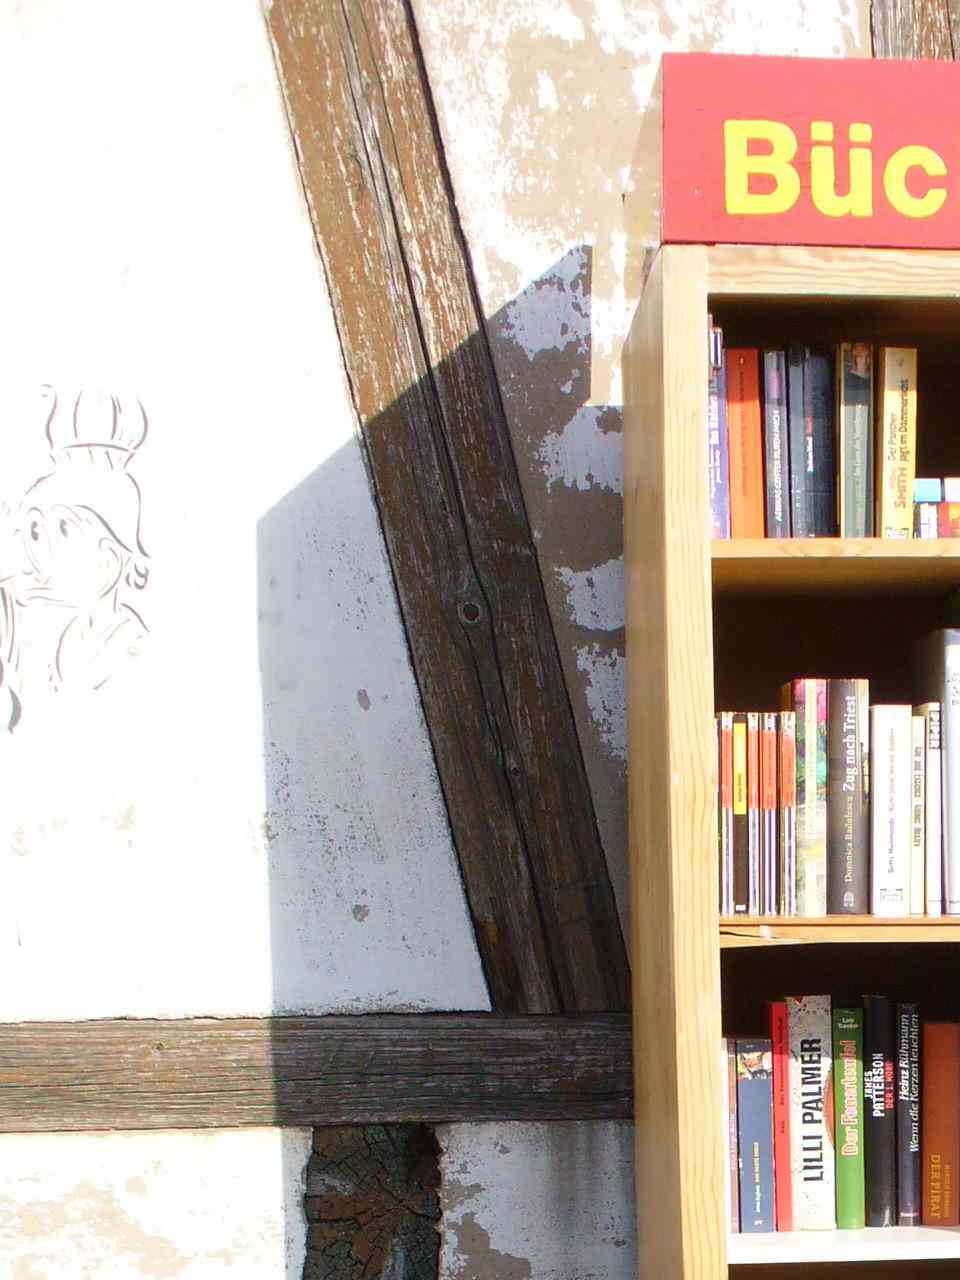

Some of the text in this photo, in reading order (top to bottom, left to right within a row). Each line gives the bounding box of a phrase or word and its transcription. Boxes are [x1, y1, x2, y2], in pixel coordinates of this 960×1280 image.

[893, 466, 907, 509] SMITH
[843, 695, 857, 732] Triest
[844, 735, 855, 765] nach
[843, 767, 858, 792] Zug
[898, 1014, 910, 1101] Heinz Rühmann
[908, 1014, 921, 1153] Wenn die Kerzen leuchten
[799, 1038, 824, 1182] LILLI PALMER
[864, 1070, 874, 1100] JAMES
[872, 1053, 885, 1117] PATTERSON
[930, 1152, 942, 1219] DER PIRAT
